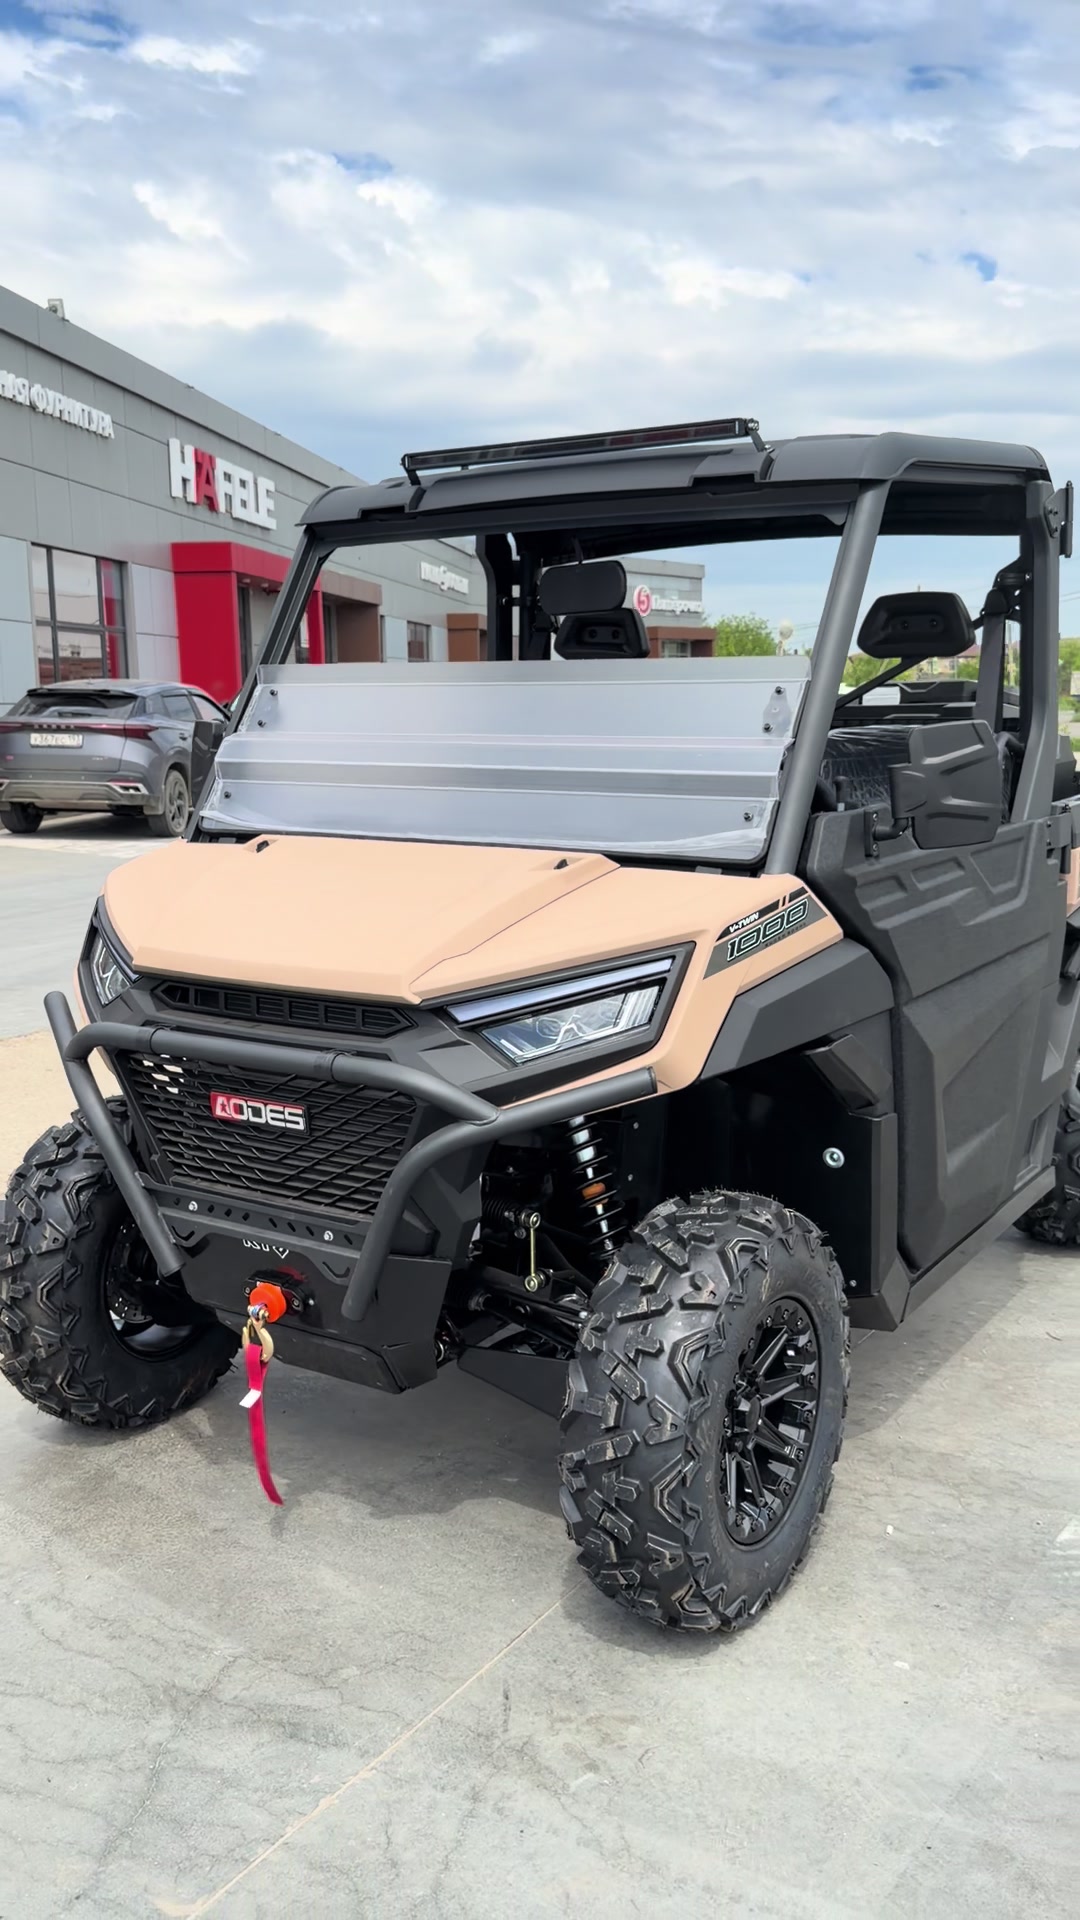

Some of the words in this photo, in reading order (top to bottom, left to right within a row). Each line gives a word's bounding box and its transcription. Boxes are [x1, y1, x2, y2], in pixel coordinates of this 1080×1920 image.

[727, 898, 809, 962] 1000
[729, 911, 759, 933] V-TWIN
[215, 1095, 305, 1131] AODES
